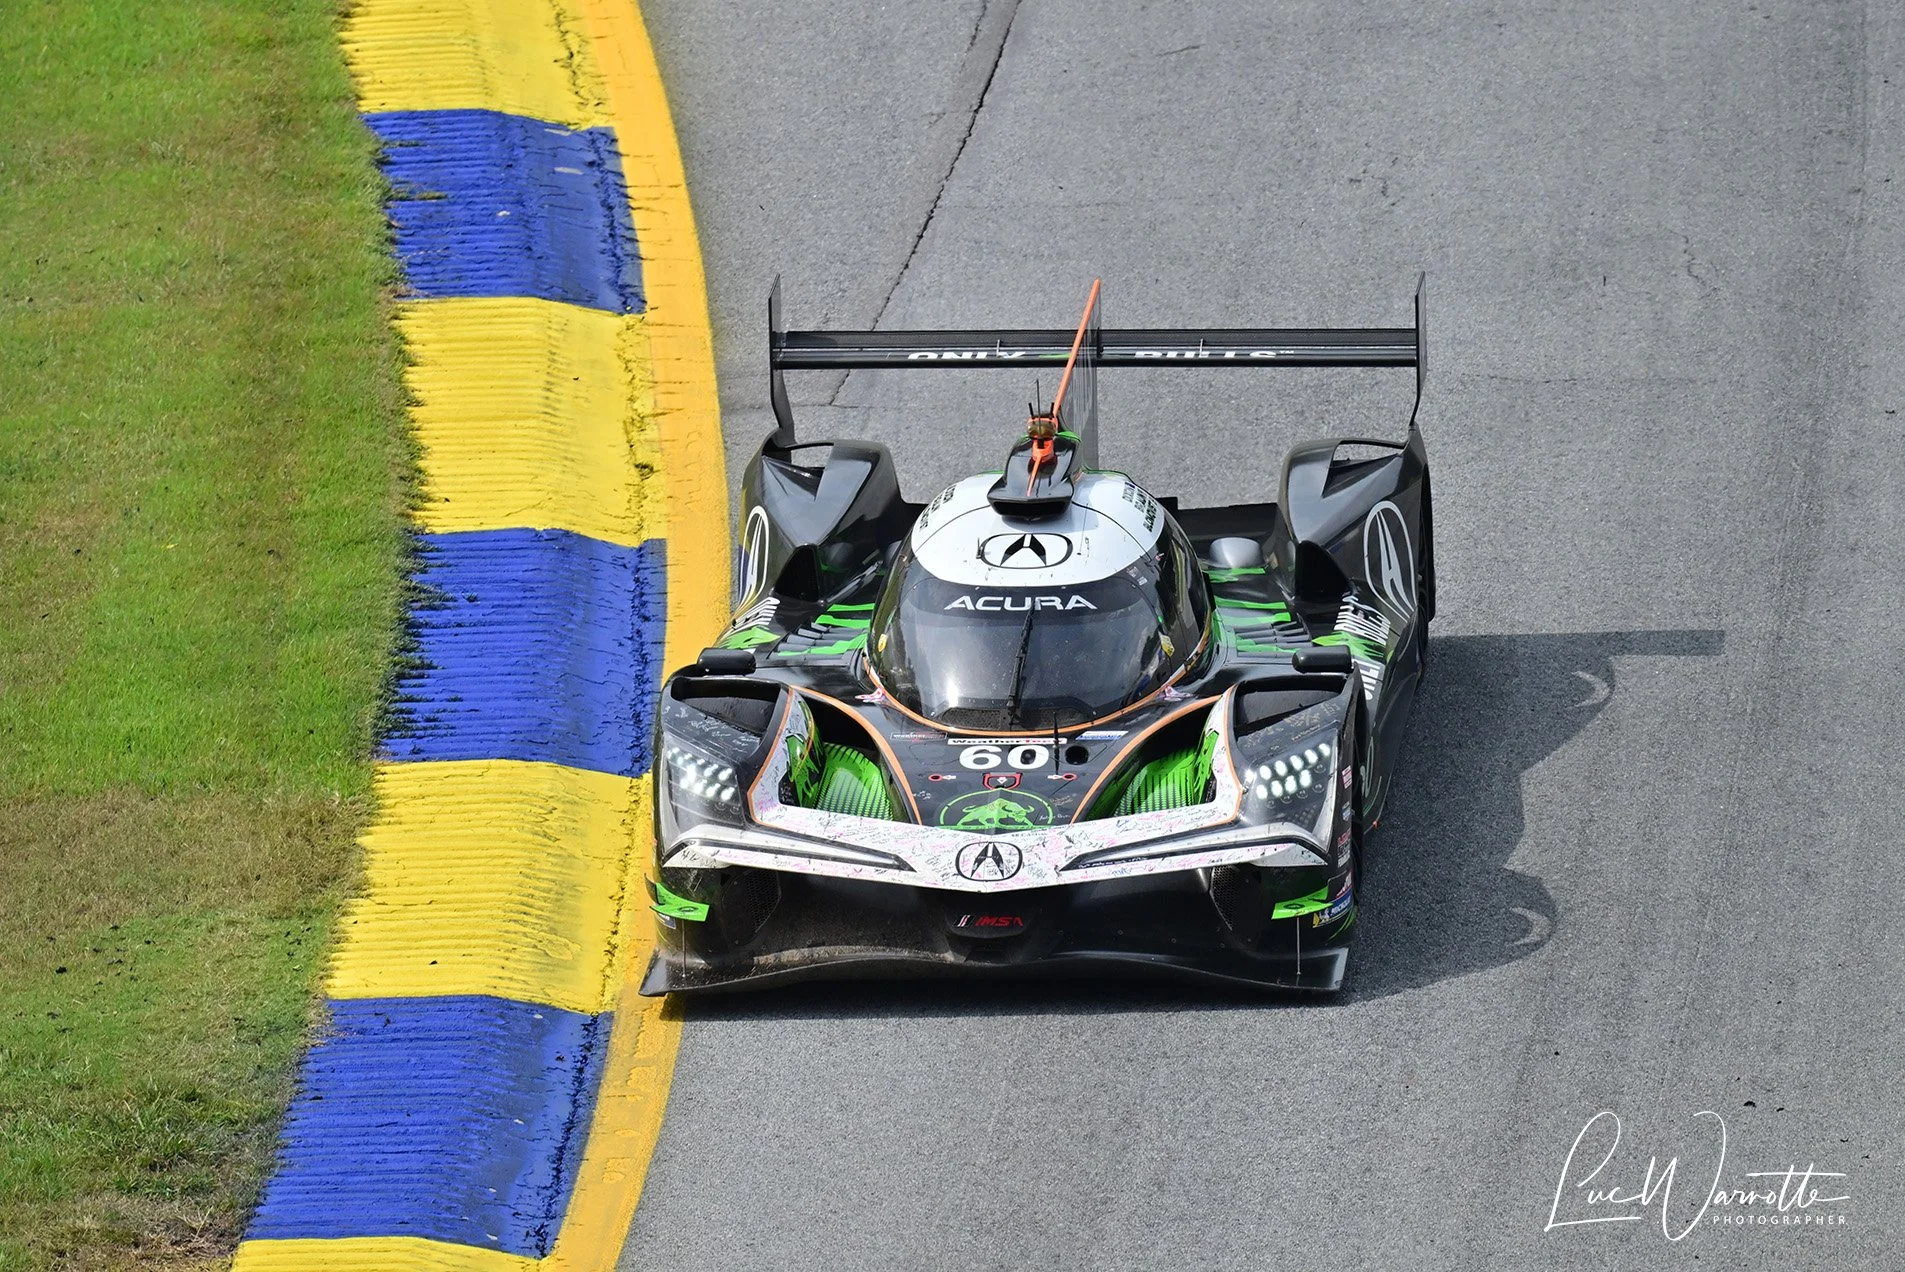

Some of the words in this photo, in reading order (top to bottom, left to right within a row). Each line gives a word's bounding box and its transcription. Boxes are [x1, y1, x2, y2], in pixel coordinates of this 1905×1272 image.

[944, 595, 1098, 611] ACURA
[959, 745, 1050, 770] 60
[975, 915, 1024, 927] IMSA
